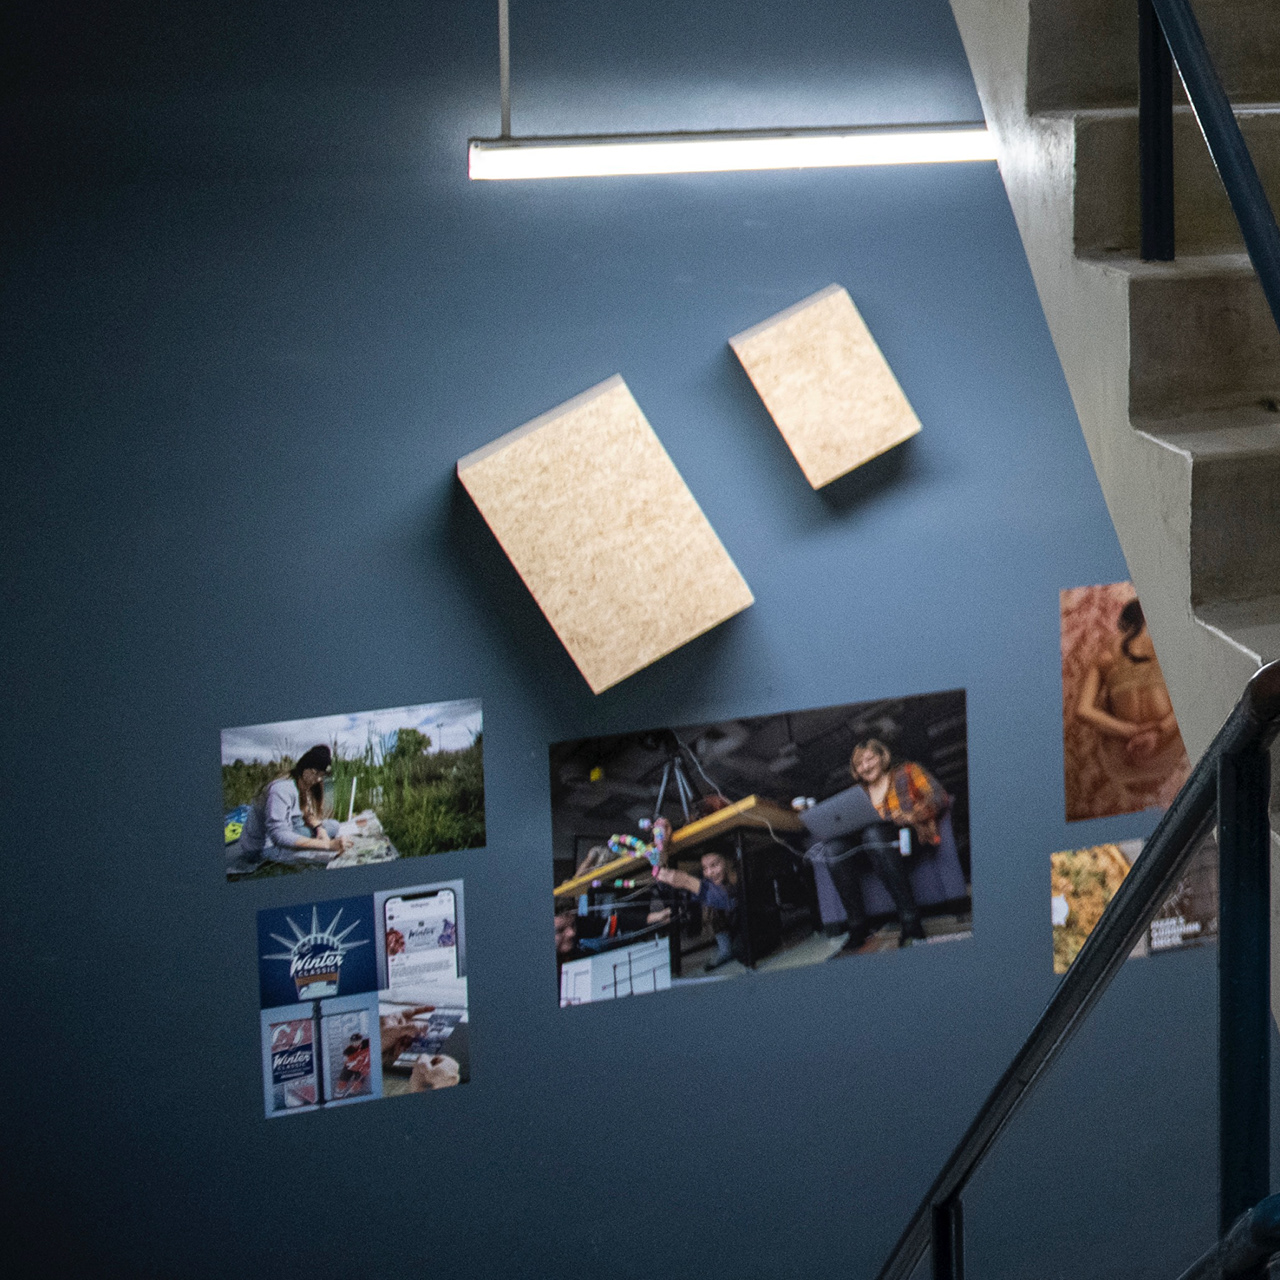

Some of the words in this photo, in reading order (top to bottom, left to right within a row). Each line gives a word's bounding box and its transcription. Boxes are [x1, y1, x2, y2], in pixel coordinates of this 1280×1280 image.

[290, 951, 346, 978] Winter
[298, 966, 336, 977] CLASSIC
[273, 1050, 312, 1070] Winter
